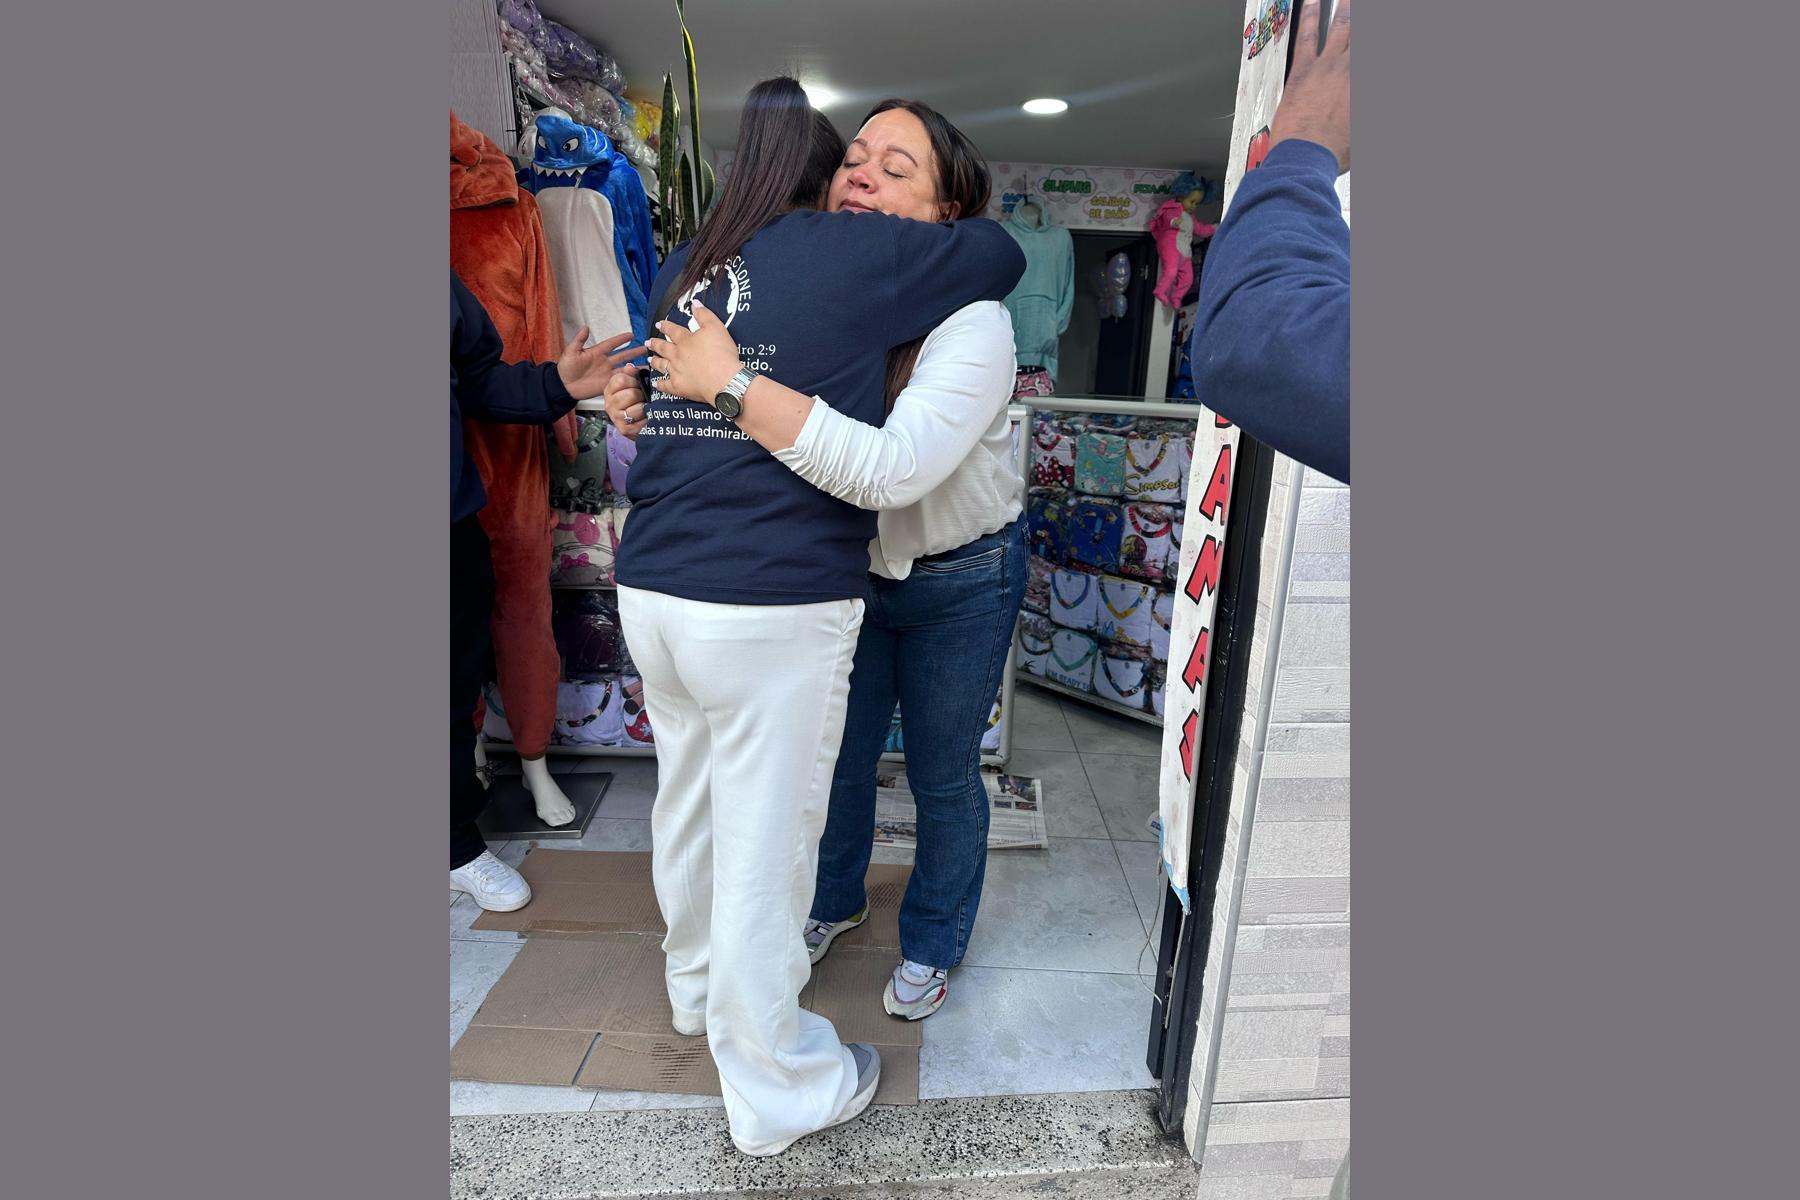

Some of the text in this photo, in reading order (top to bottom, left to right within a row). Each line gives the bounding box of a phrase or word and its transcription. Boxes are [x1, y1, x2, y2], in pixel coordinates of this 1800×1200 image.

[727, 255, 752, 312] CIONES
[758, 344, 776, 356] 2:9
[741, 358, 773, 373] ido,
[654, 410, 670, 421] que
[672, 410, 685, 419] os
[659, 426, 664, 435] a
[666, 426, 676, 435] su
[679, 424, 693, 435] luz
[697, 425, 753, 441] admirab
